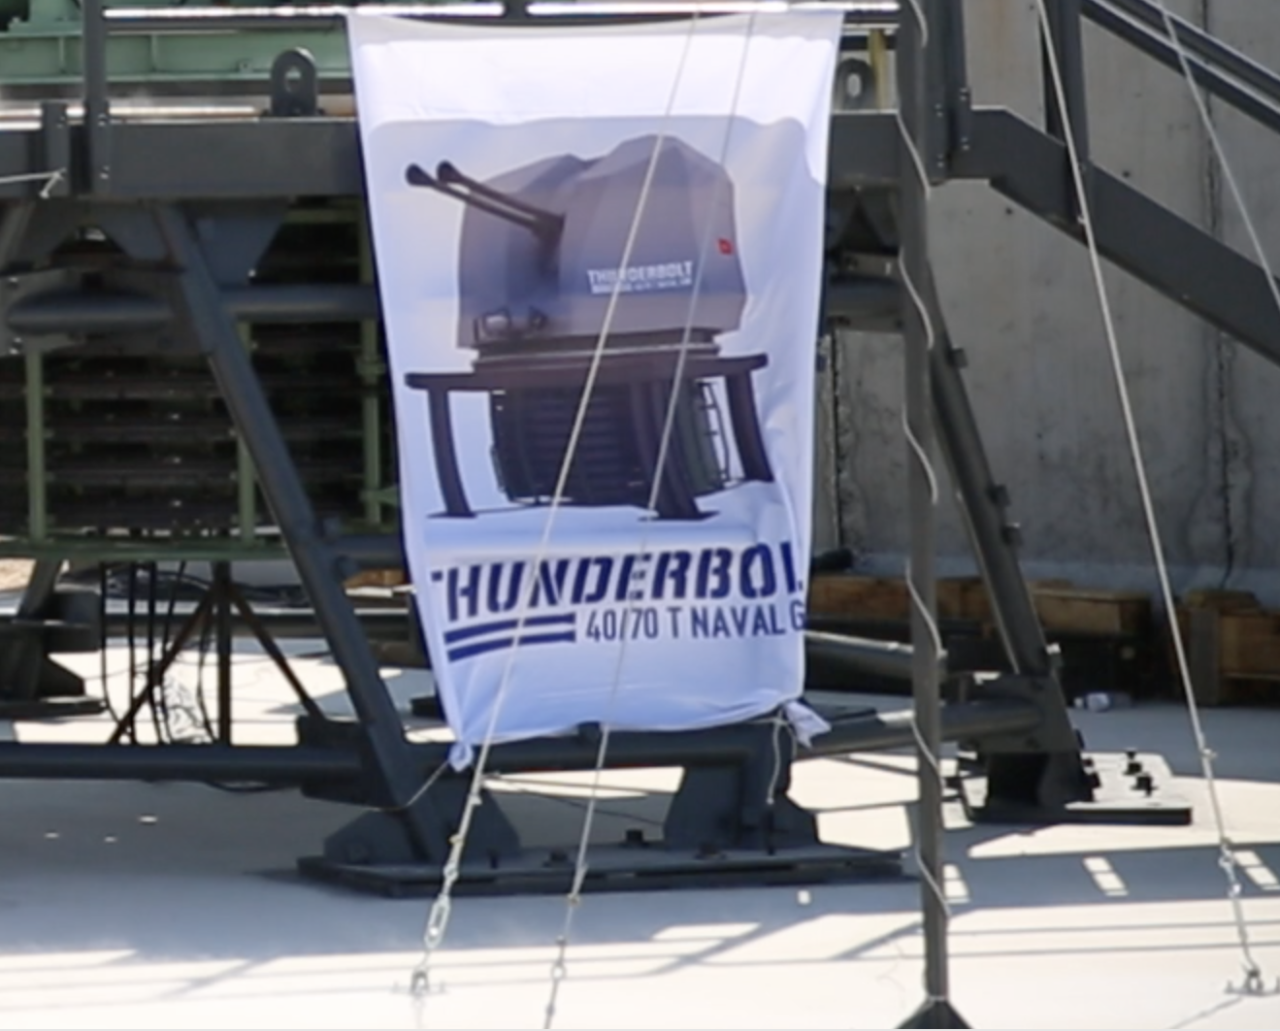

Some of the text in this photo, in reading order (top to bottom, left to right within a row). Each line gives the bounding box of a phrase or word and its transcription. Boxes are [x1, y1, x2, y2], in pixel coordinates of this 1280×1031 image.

[430, 541, 804, 622] HUNDERBOL
[585, 607, 659, 642] 40/70
[667, 606, 682, 639] T
[691, 604, 787, 639] NAVAL
